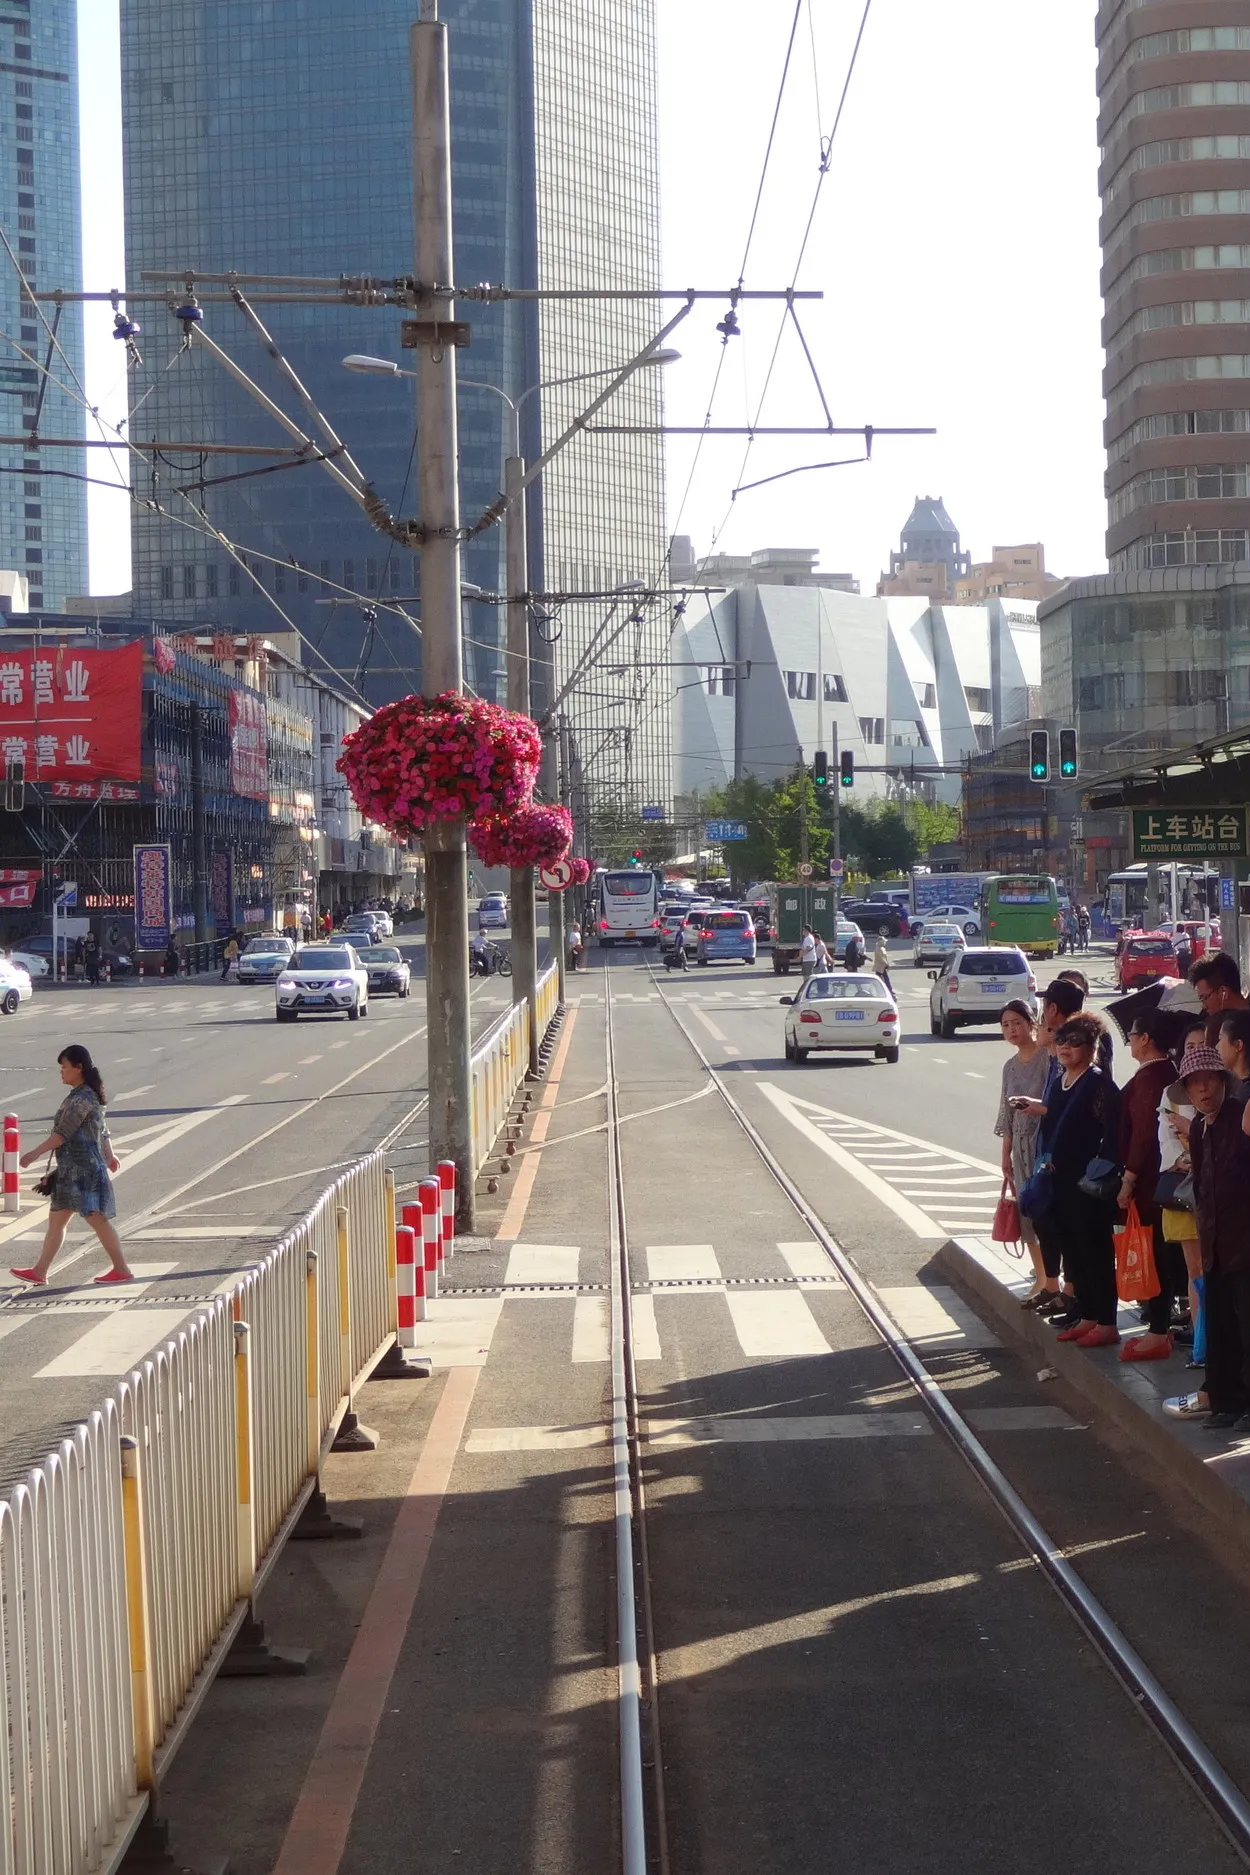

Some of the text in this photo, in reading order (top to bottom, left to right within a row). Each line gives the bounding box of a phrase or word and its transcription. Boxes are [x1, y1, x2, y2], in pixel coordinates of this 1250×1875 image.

[0, 660, 90, 705] 常营业
[1140, 814, 1240, 840] 上车站台
[1140, 842, 1240, 852] PLATFORM FOR GETTING ON THE BUS
[802, 865, 811, 873] 40
